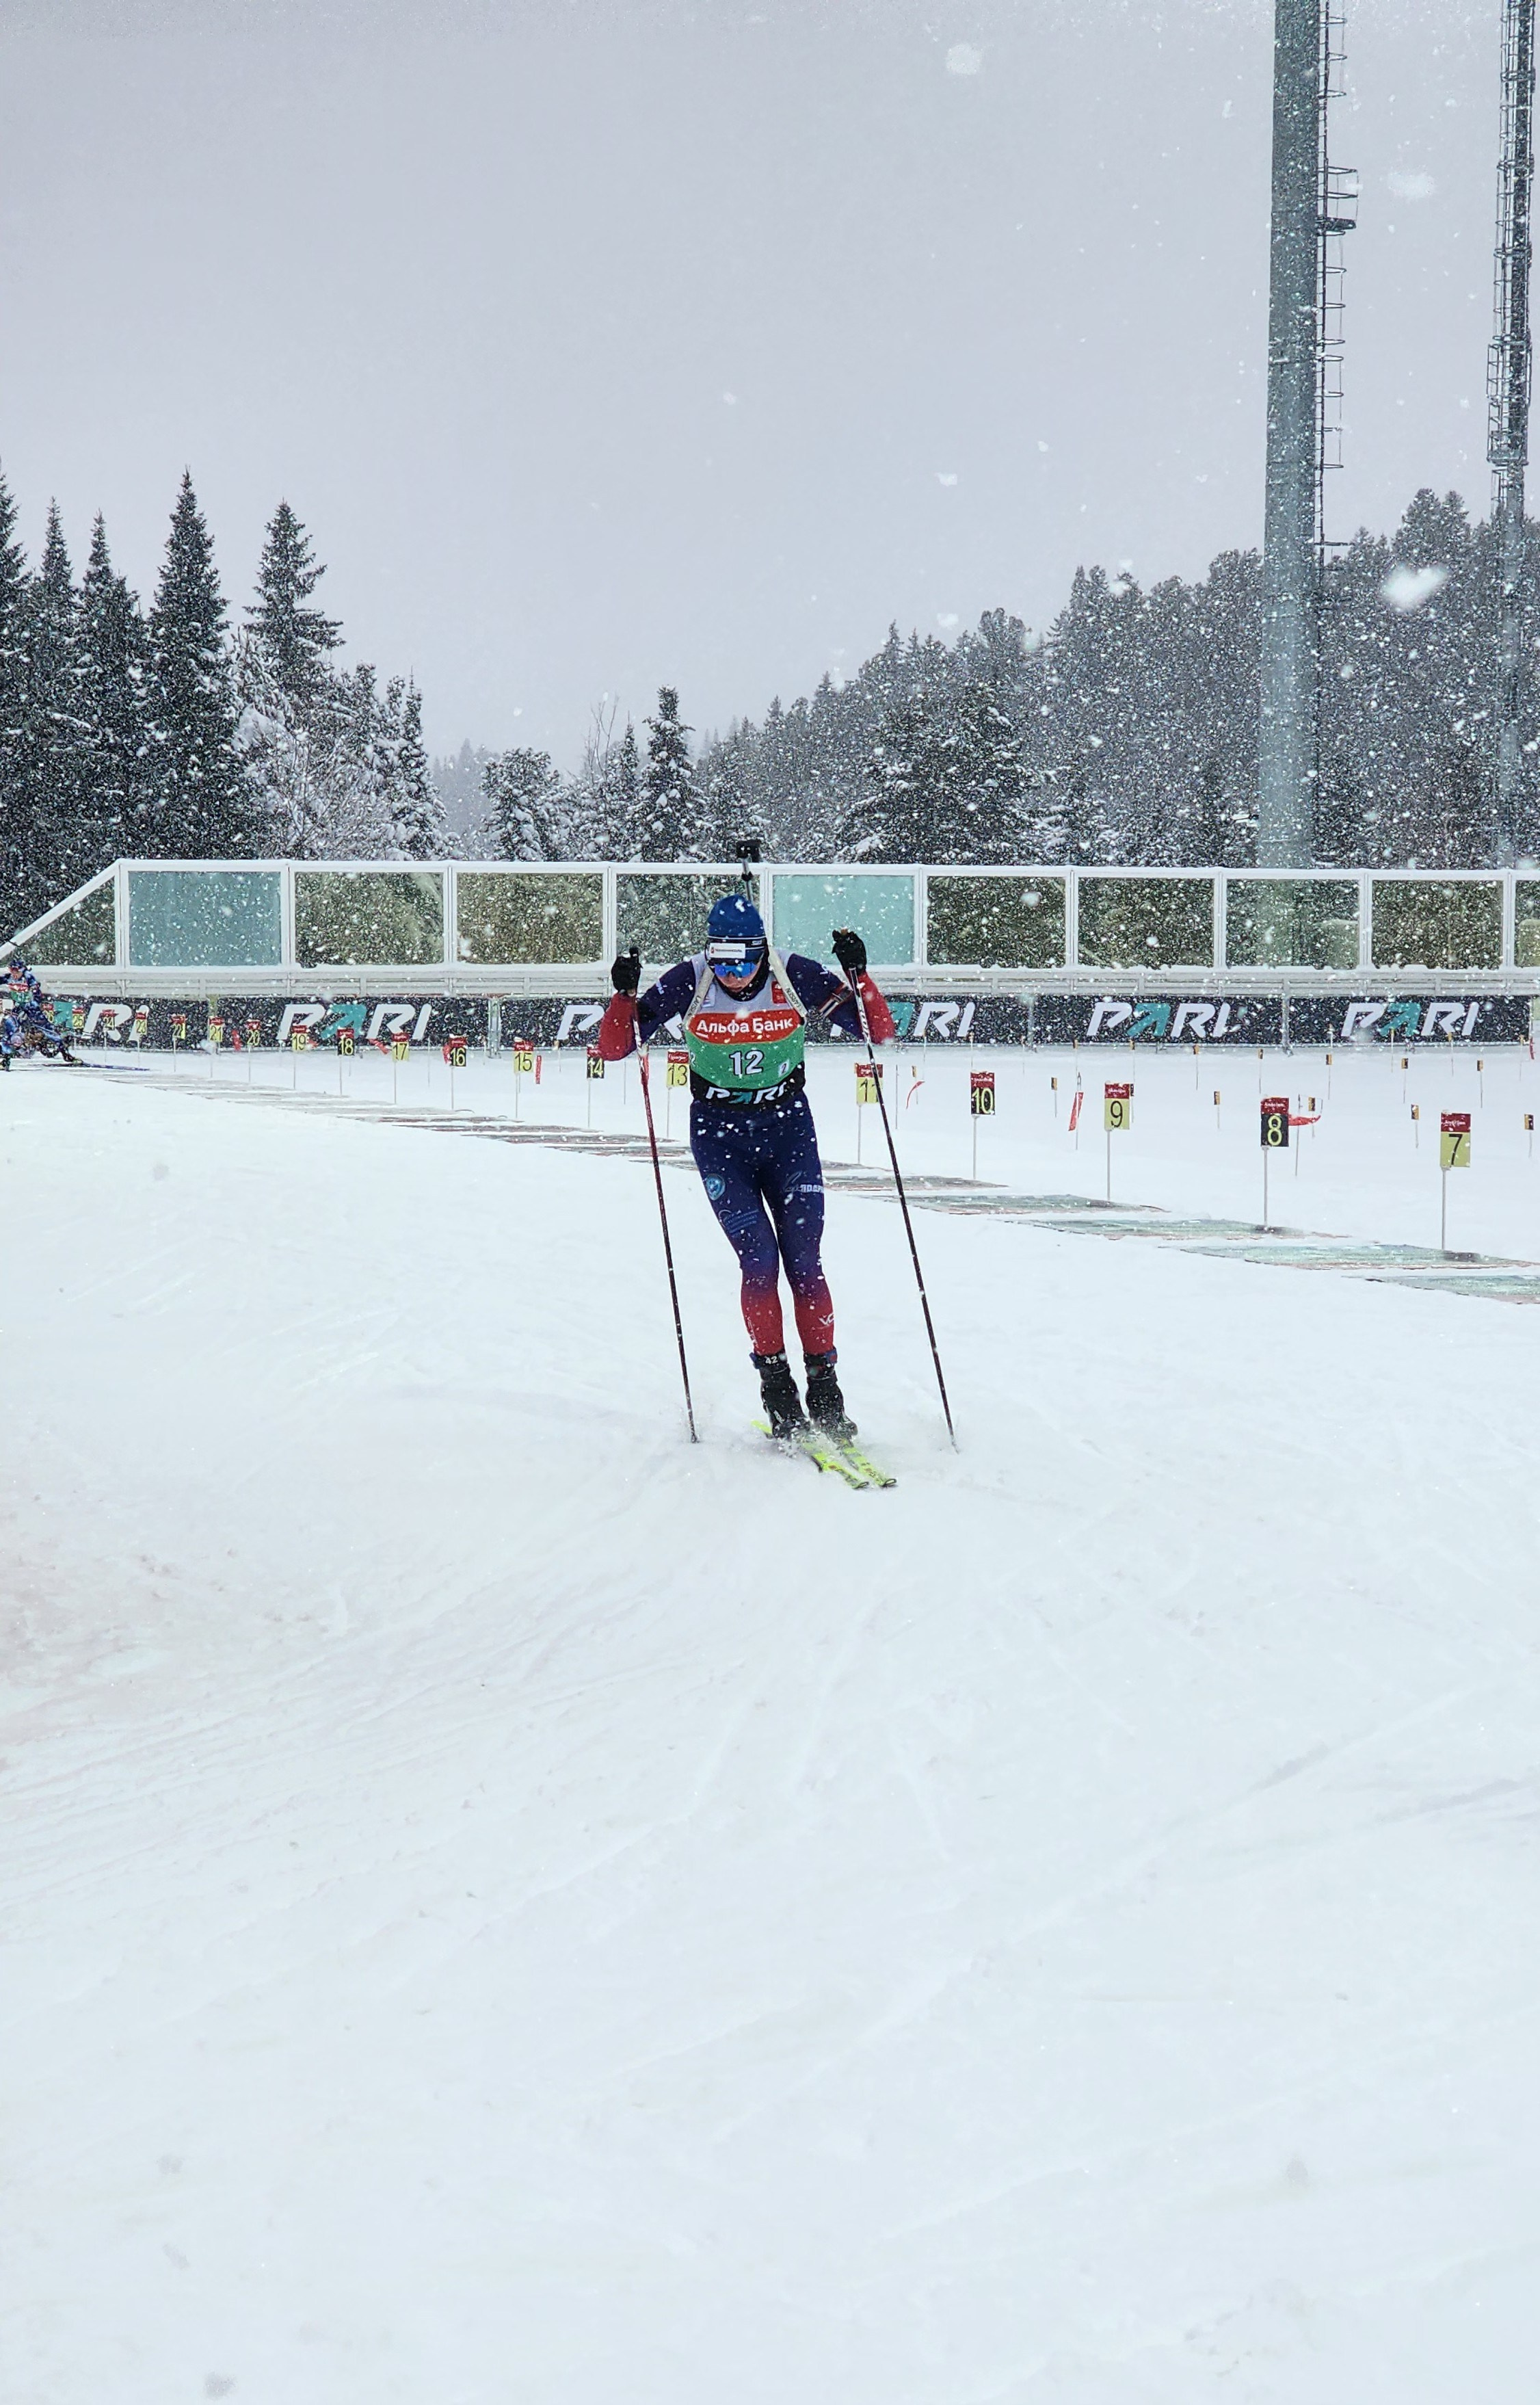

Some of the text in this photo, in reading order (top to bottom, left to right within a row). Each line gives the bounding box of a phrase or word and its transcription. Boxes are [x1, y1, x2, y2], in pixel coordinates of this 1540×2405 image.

[103, 1016, 114, 1031] 24
[276, 1003, 432, 1040] PARI
[696, 1019, 750, 1036] Альфа
[752, 1016, 793, 1033] Банк
[1085, 1001, 1230, 1038] PARI
[1340, 1002, 1480, 1037] PARI
[210, 1025, 222, 1041] 21
[248, 1029, 260, 1046] 20
[293, 1033, 306, 1051] 19
[339, 1038, 354, 1055] 18
[393, 1042, 408, 1060] 17
[450, 1047, 465, 1066] 16
[514, 1052, 532, 1072] 15
[587, 1057, 604, 1078] 14
[729, 1050, 765, 1076] 12
[667, 1064, 688, 1086] 13
[705, 1083, 786, 1105] PARI
[971, 1087, 994, 1114] 10
[1110, 1100, 1123, 1128] 9
[1266, 1114, 1283, 1146] 8
[1448, 1133, 1463, 1167] 7
[765, 1355, 778, 1365] 42
